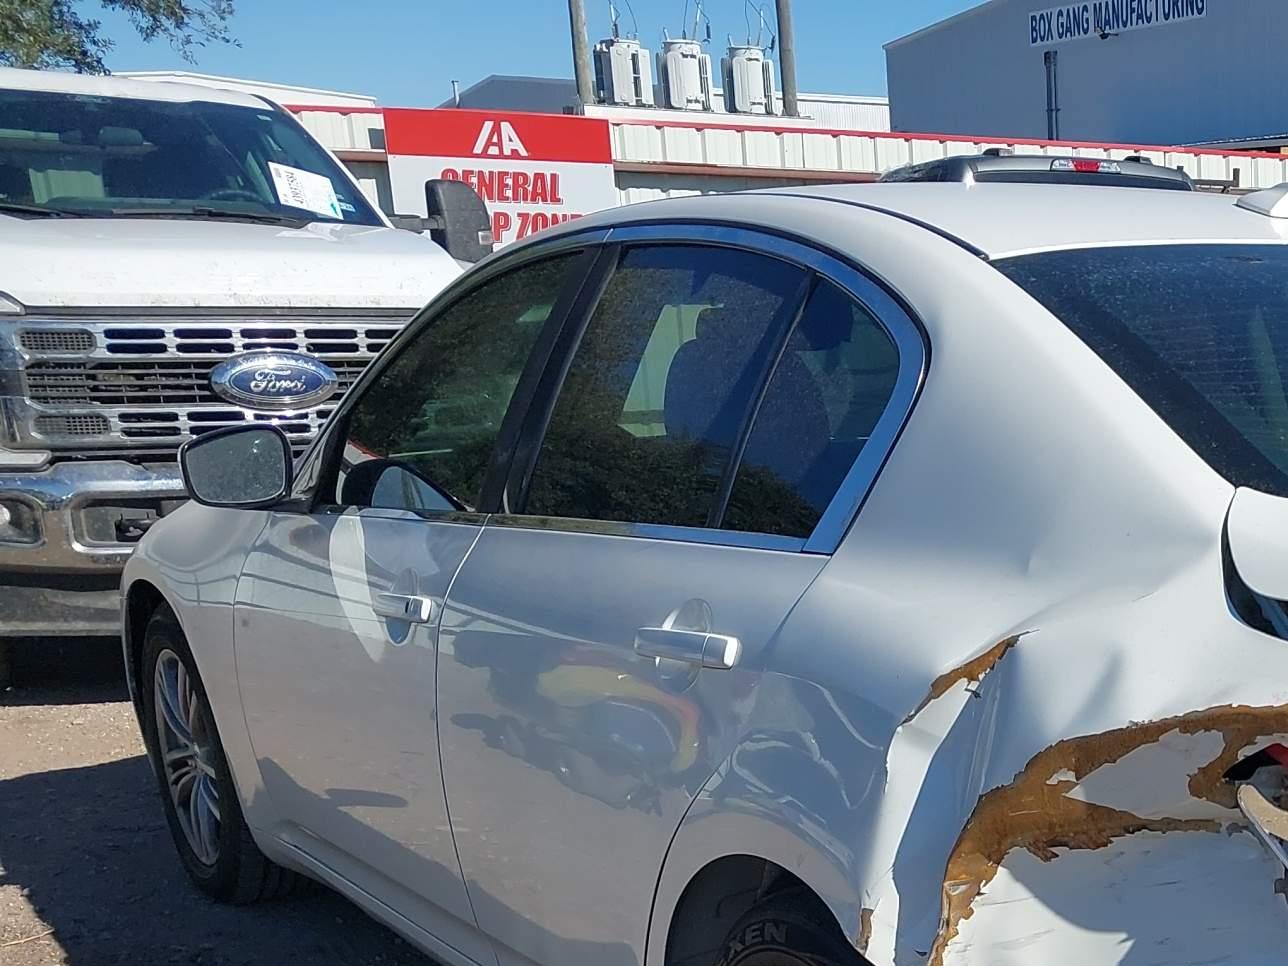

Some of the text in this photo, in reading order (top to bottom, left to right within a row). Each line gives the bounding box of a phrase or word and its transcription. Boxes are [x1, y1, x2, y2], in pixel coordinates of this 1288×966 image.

[1030, 0, 1206, 45] BOX GANG MANUFACTURING
[516, 212, 585, 241] ZO
[249, 368, 307, 393] Ford
